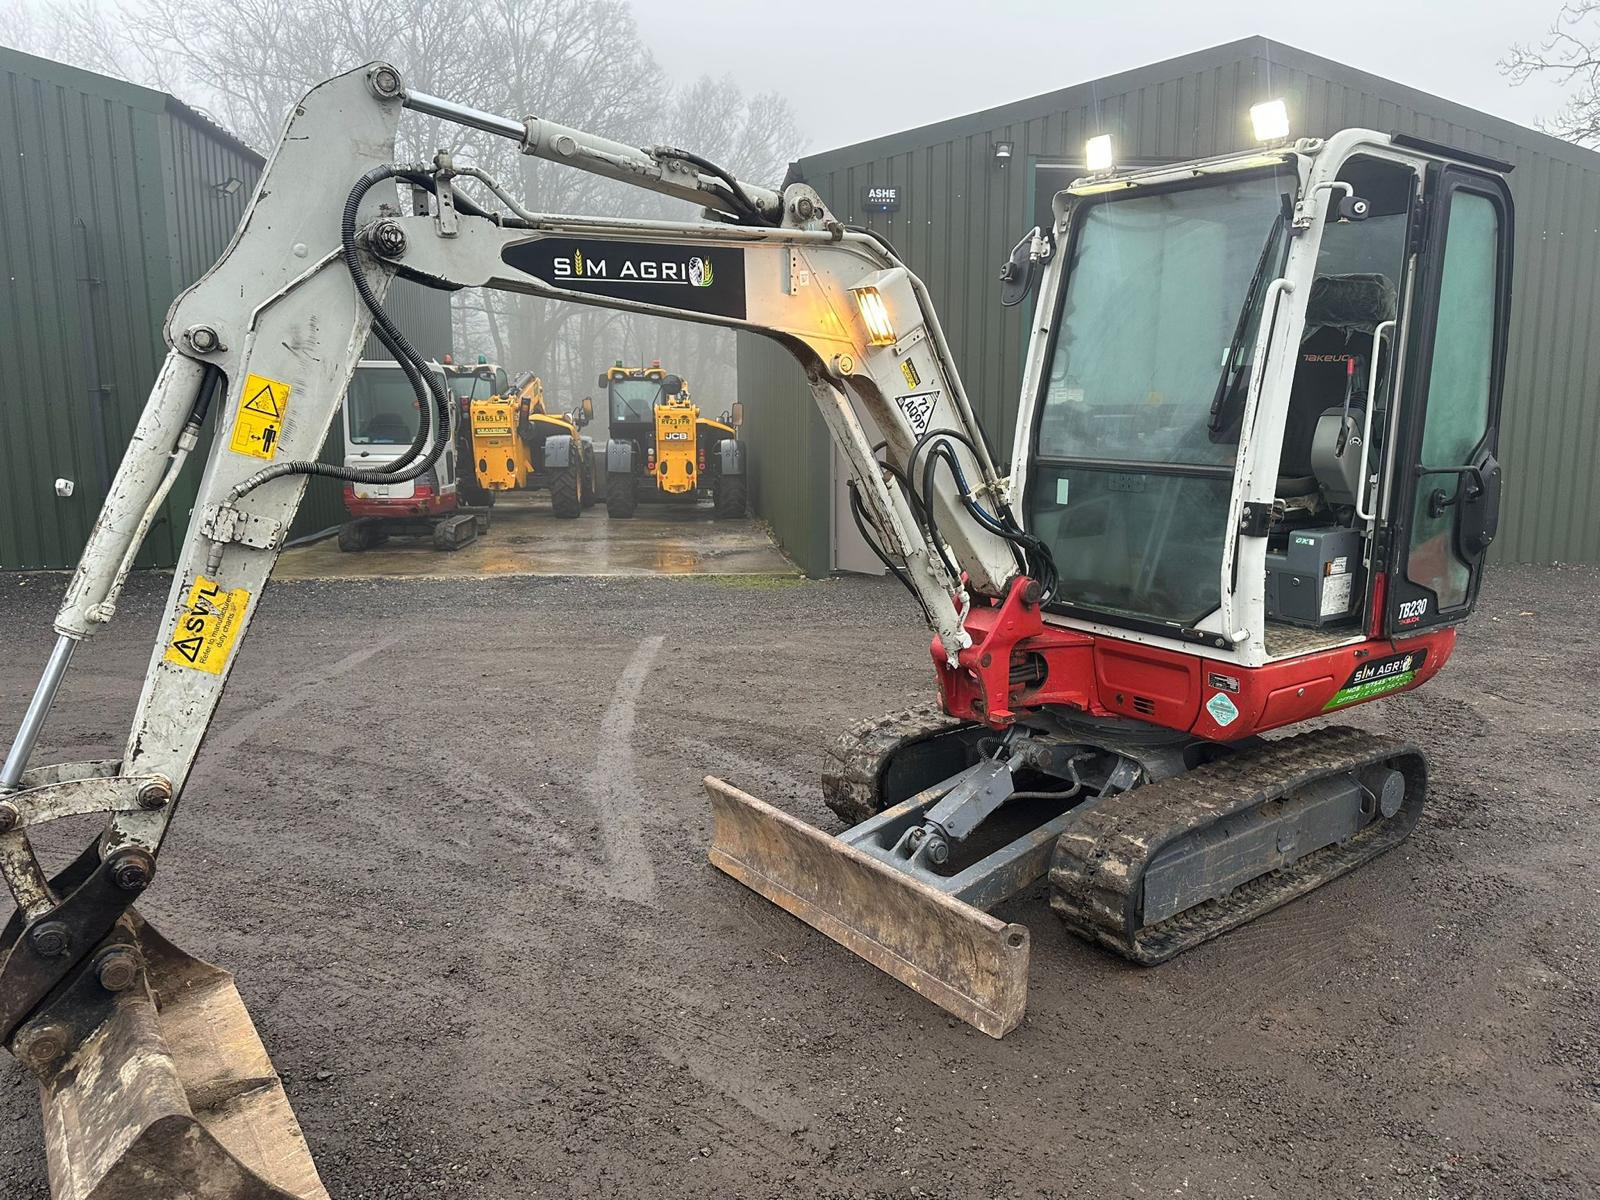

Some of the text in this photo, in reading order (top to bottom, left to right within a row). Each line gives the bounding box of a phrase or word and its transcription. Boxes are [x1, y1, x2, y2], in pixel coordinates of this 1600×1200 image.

[868, 188, 896, 198] ASHE
[553, 249, 607, 277] SIM
[904, 400, 926, 430] AQ9P
[917, 397, 930, 417] 71
[665, 432, 687, 440] JCB
[186, 585, 219, 633] SWL
[1398, 598, 1428, 620] TB230
[199, 646, 211, 664] Refer
[211, 592, 234, 638] manufacturers
[217, 613, 234, 648] duty charts
[1353, 664, 1375, 682] SIM
